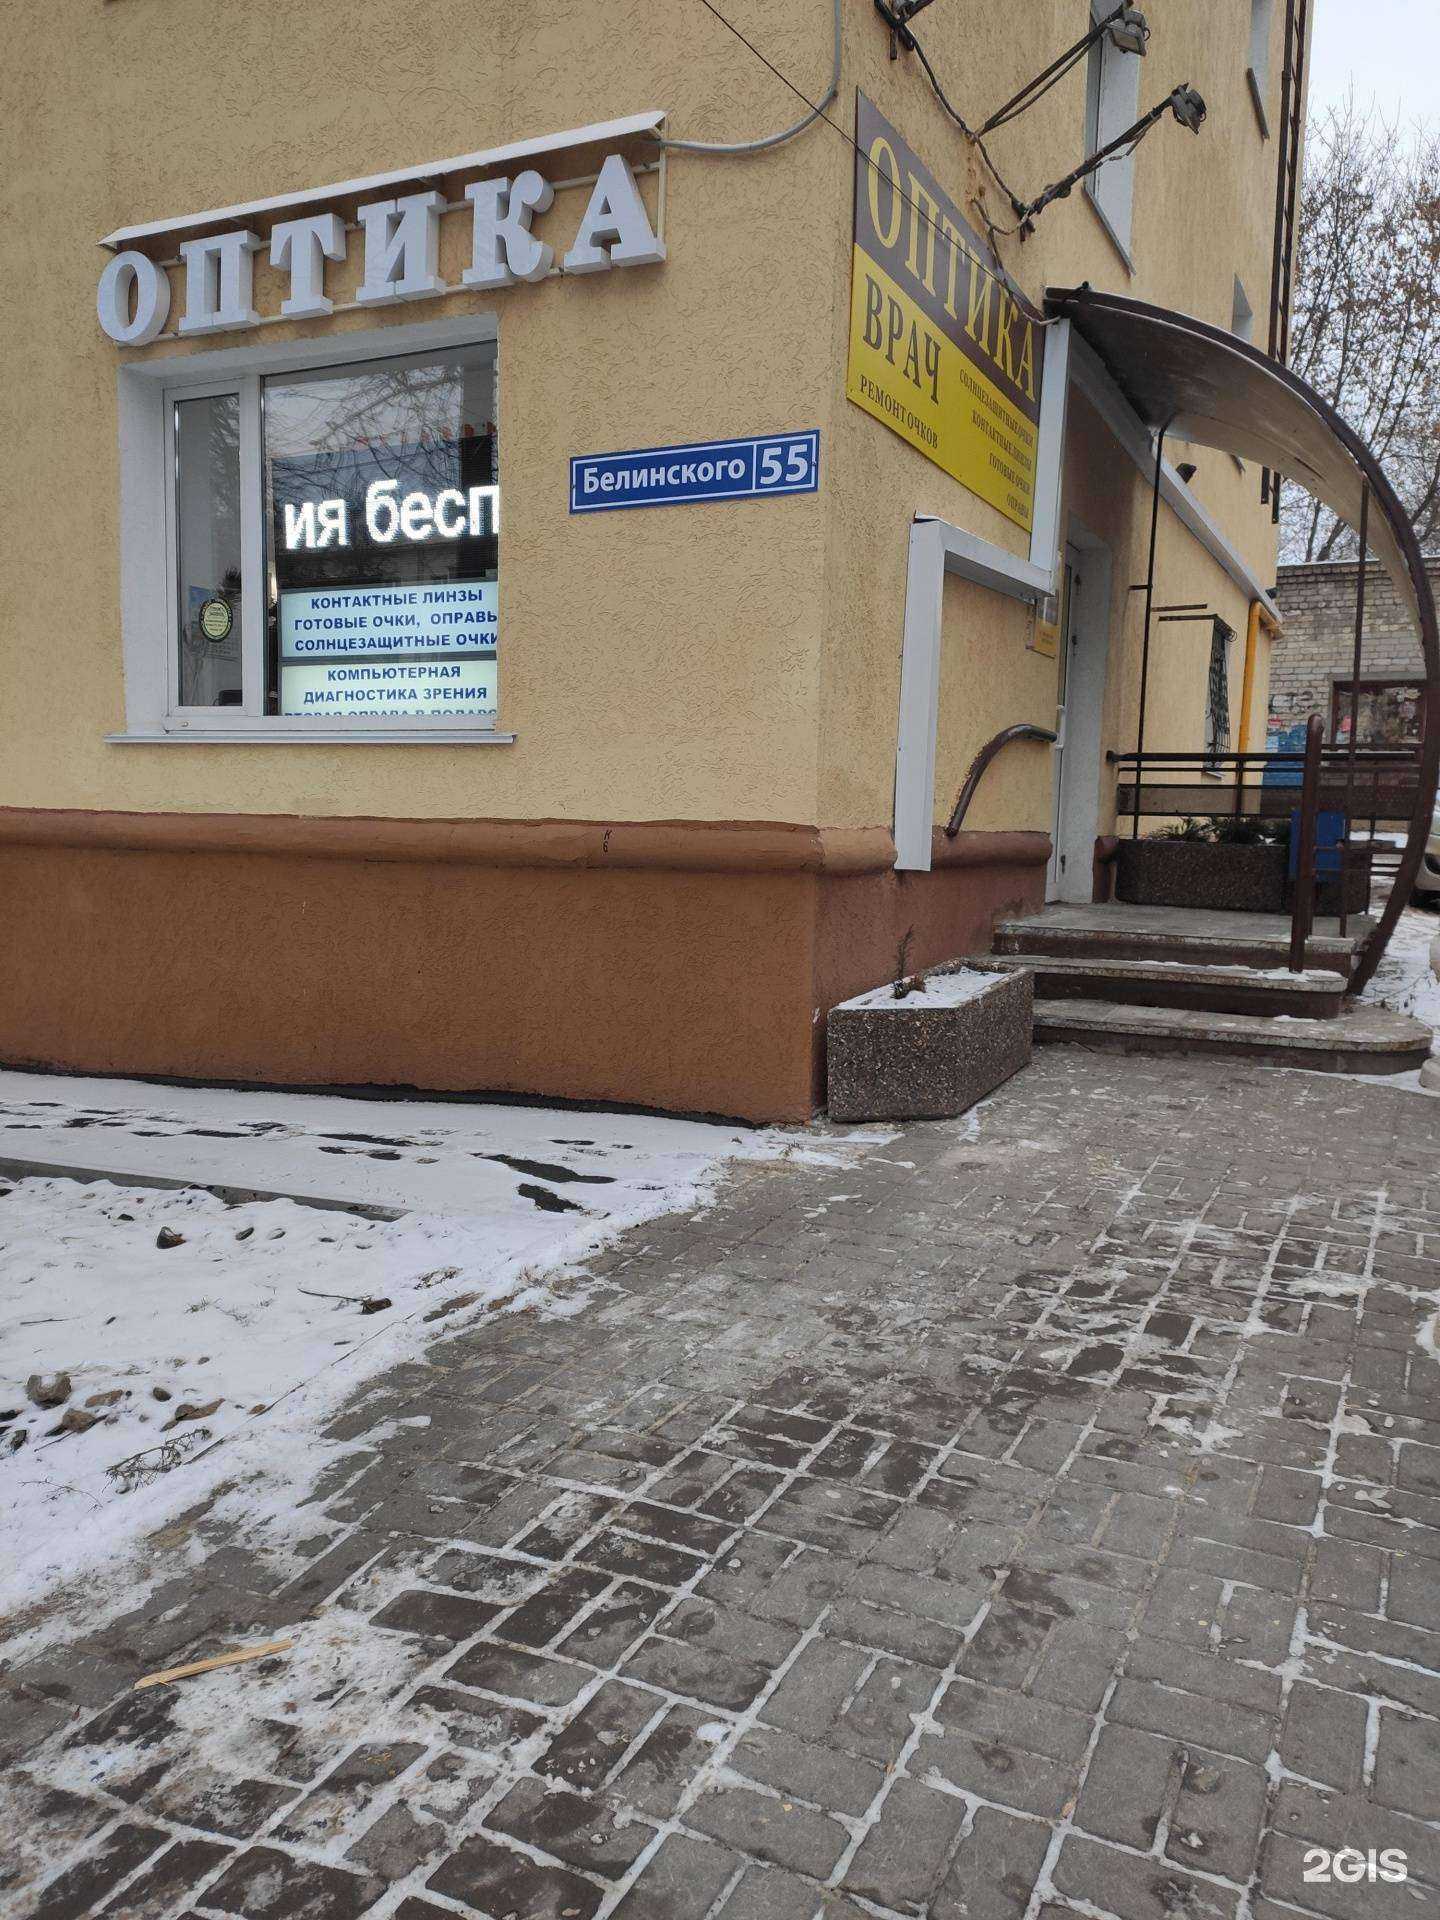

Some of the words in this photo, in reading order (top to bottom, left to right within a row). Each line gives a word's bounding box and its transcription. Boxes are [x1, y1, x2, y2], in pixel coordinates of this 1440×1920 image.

[97, 154, 666, 347] ОПТИКА
[868, 136, 1036, 403] ОПТИКА
[862, 273, 941, 406] ВРАЧ
[860, 374, 906, 424] РЕМОНТ
[907, 411, 938, 449] ОЧКОВ
[583, 458, 746, 494] Белинского
[760, 444, 808, 484] 55
[311, 592, 417, 609] КОНТАКТНЫЕ
[422, 589, 482, 603] ЛИНЗЫ
[294, 616, 367, 630] ГОТОВЫЕ
[373, 614, 420, 628] ОЧКИ,
[295, 635, 450, 651] СОЛНЦЕЗАЩИТНЫЕ
[327, 666, 461, 681] КОМПЬЮТЕРНАЯ
[303, 689, 417, 705] ДИАГНОСТИКА
[423, 687, 487, 700] ЗРЕНИЯ
